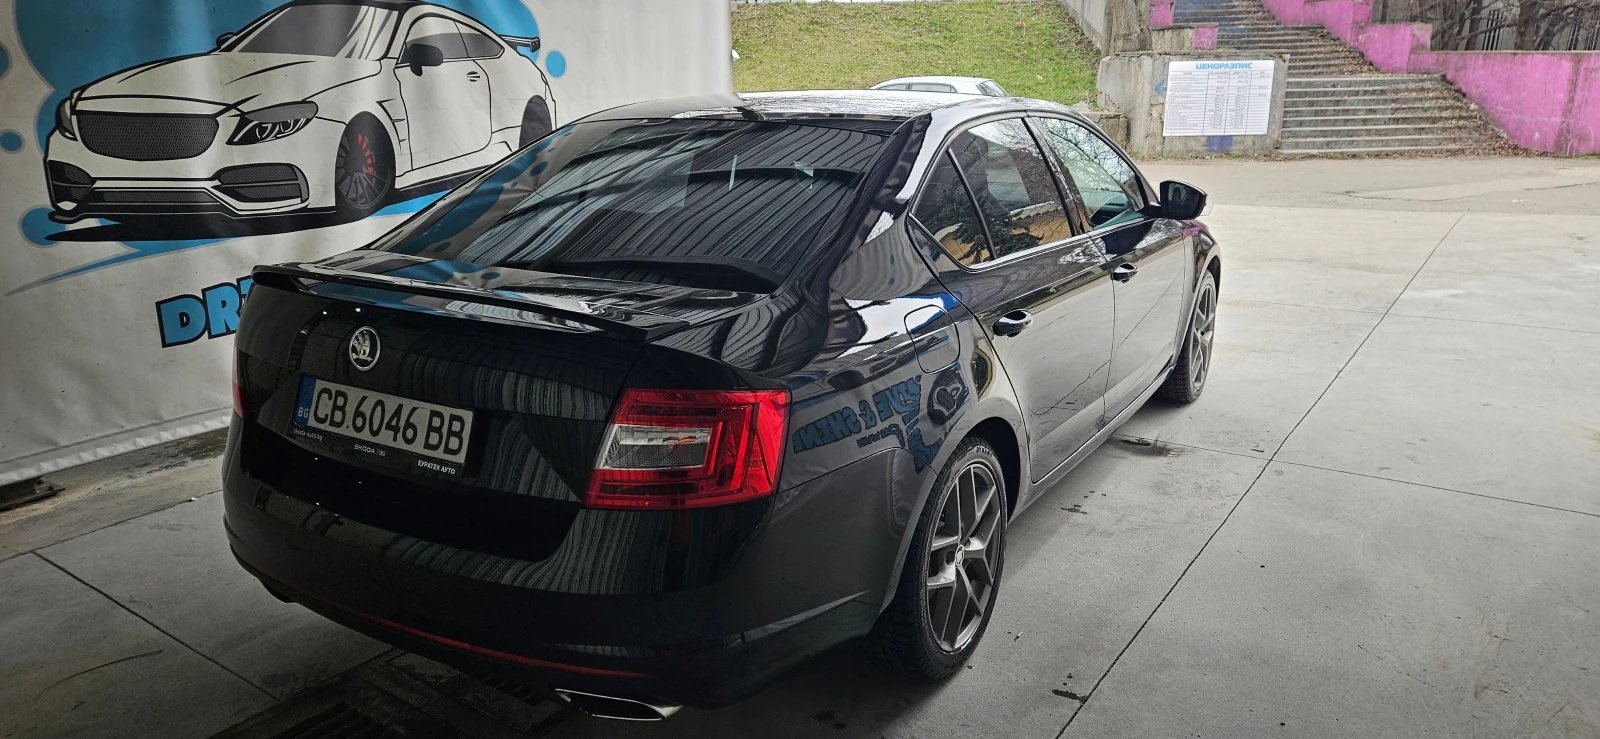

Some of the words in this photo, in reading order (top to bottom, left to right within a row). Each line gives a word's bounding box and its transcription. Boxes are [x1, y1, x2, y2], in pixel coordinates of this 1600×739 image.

[1195, 62, 1253, 70] ЦЕНОРАЗПИС
[297, 406, 309, 419] BG
[423, 409, 466, 456] BB
